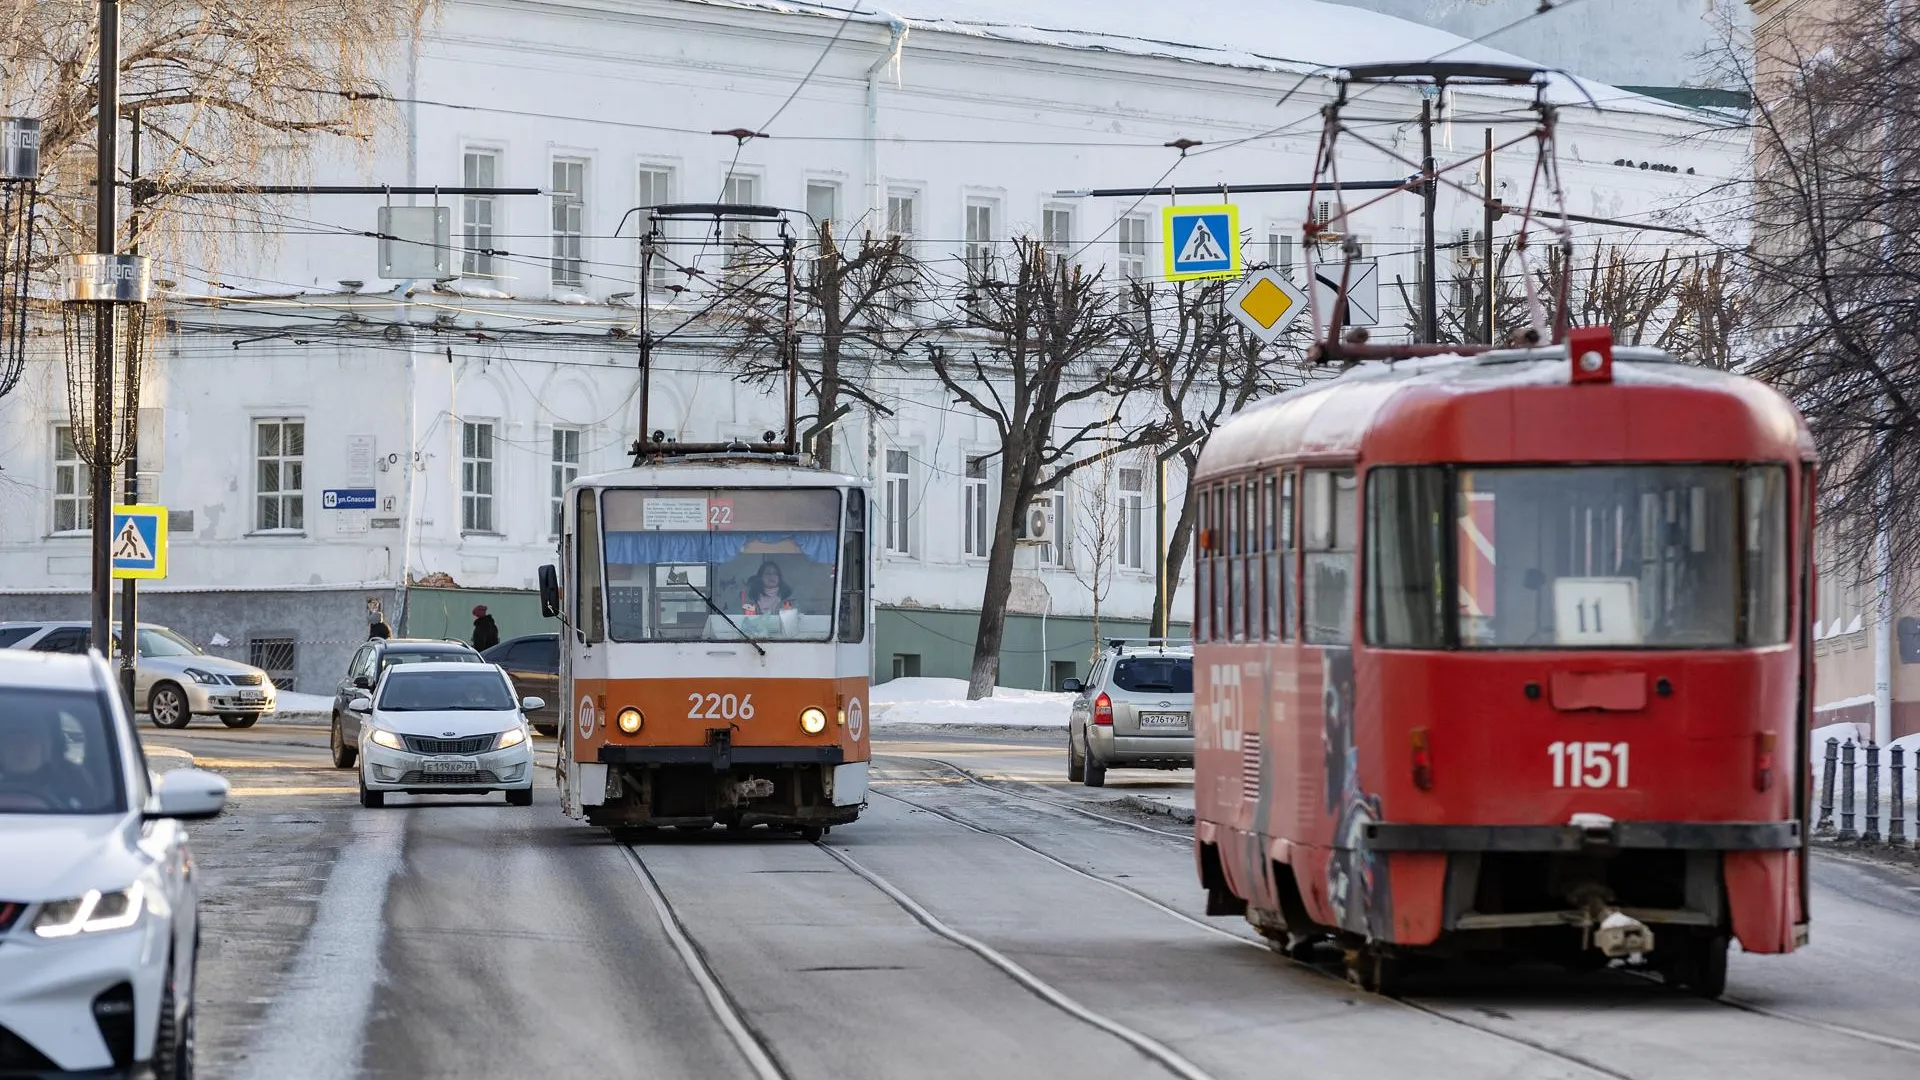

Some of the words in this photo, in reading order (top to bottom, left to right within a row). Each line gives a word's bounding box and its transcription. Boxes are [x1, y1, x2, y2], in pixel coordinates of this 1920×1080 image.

[326, 494, 336, 505] 14
[383, 499, 392, 511] 14
[710, 506, 731, 524] 22
[1575, 597, 1603, 633] 11
[688, 692, 755, 720] 2206
[1547, 741, 1629, 787] 1151
